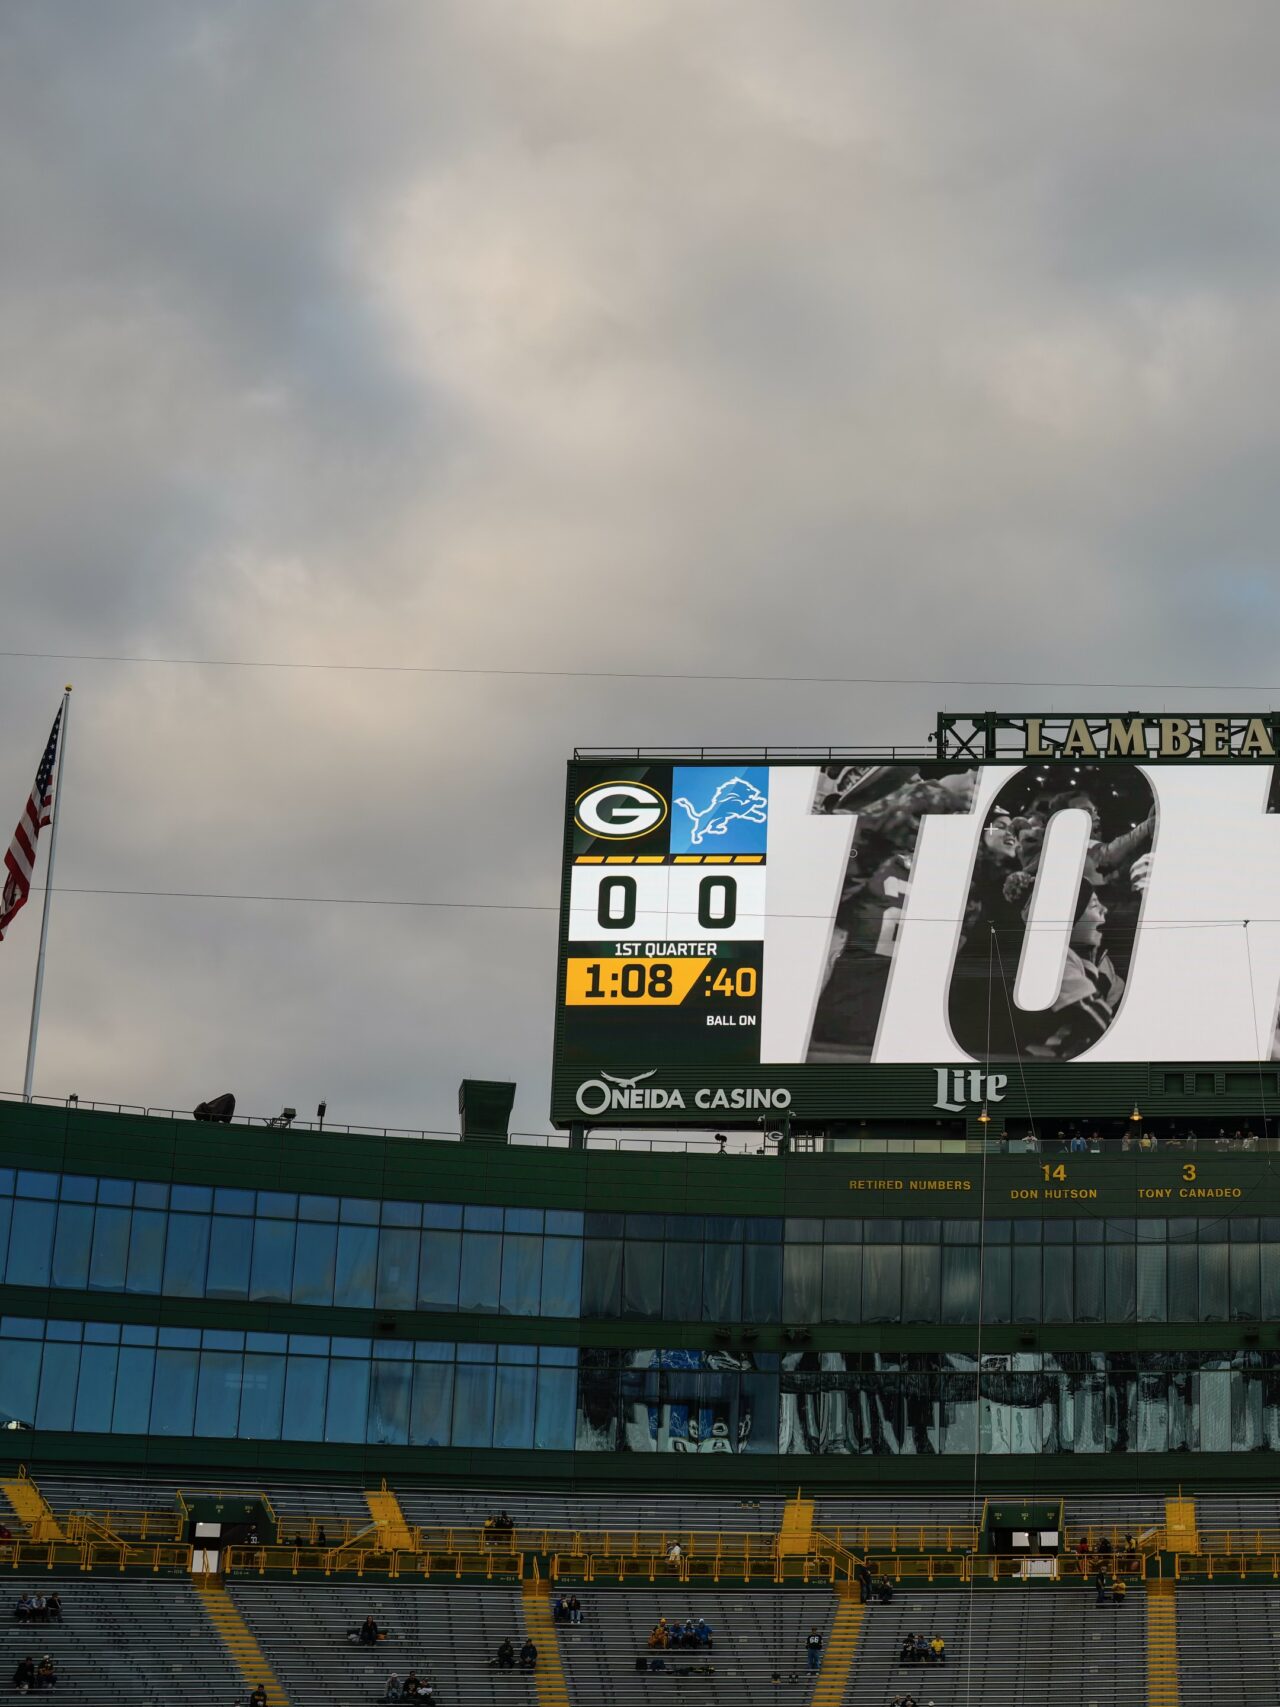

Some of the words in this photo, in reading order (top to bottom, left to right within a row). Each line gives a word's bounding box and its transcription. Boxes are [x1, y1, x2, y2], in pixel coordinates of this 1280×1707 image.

[598, 876, 637, 929] 0
[698, 875, 737, 929] 0
[805, 765, 1160, 1063] TO
[615, 943, 642, 956] 1ST
[646, 943, 718, 957] QUARTER
[585, 963, 673, 998] 1:08
[704, 967, 757, 998] :40
[706, 1016, 735, 1026] BALL
[738, 1016, 757, 1026] ON
[576, 1079, 686, 1115] ONEIDA
[695, 1087, 792, 1110] CASINO
[932, 1068, 1008, 1112] Lite
[1041, 1164, 1067, 1182] 14
[1182, 1164, 1196, 1181] 3
[849, 1180, 903, 1190] RETIRED
[909, 1180, 971, 1190] NUMBERS
[1010, 1189, 1038, 1199] DON
[1044, 1188, 1097, 1199] HUTSON
[1138, 1188, 1174, 1198] TONY
[1179, 1188, 1241, 1198] CANADEO
